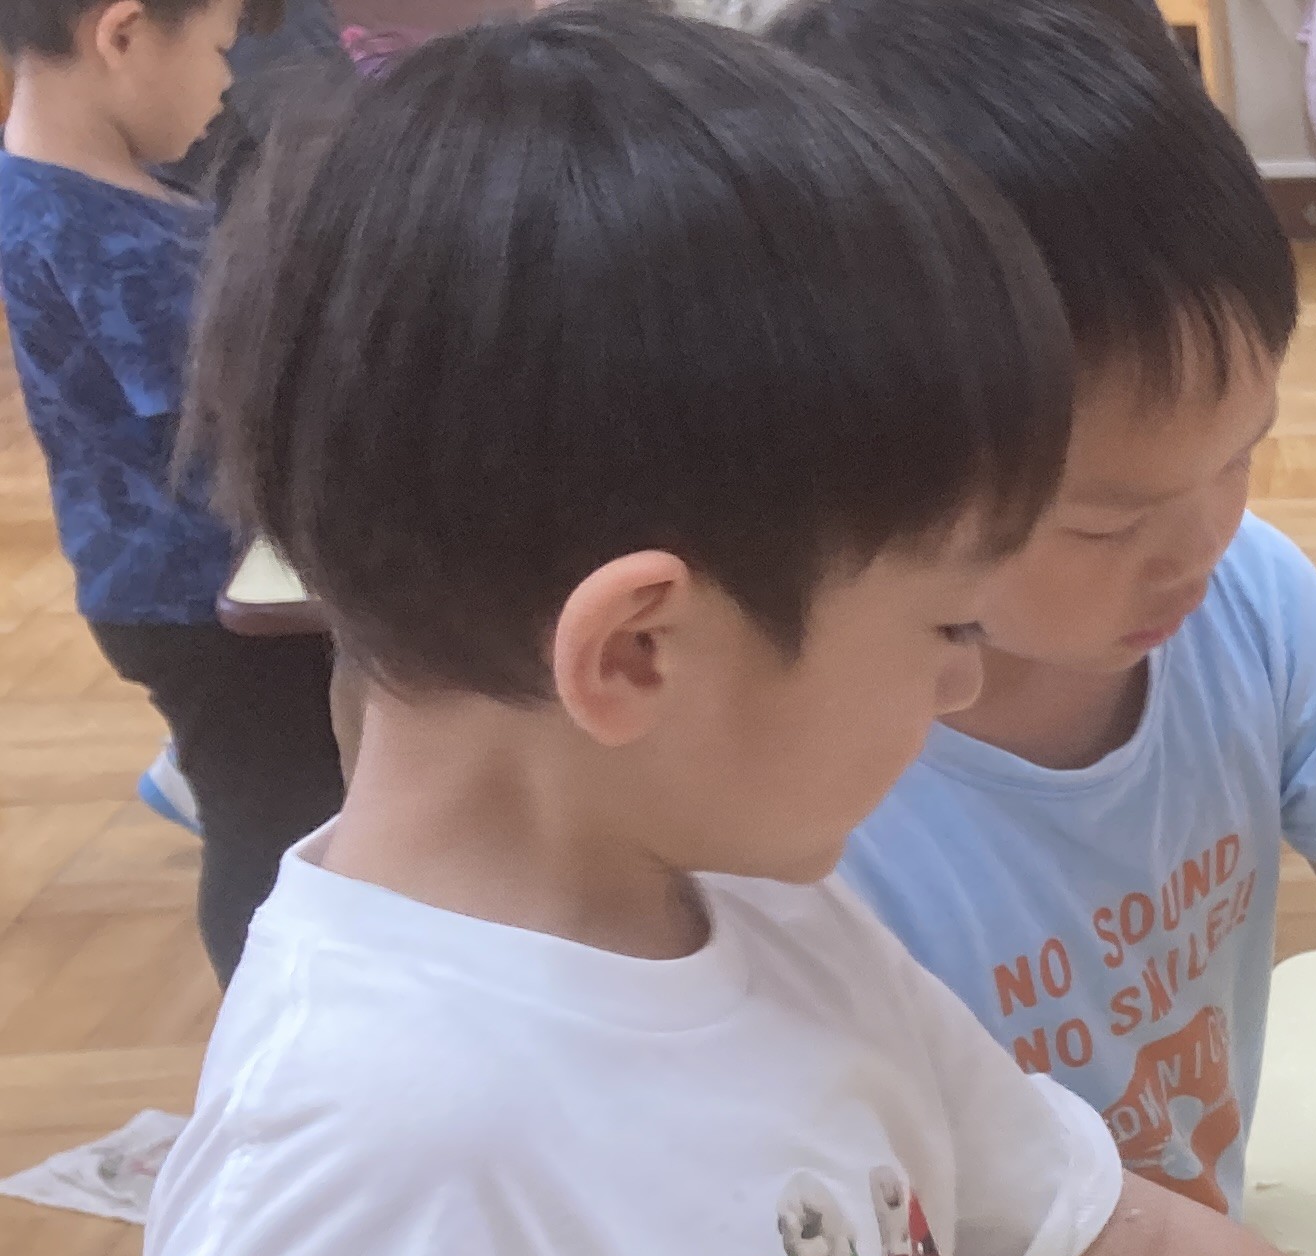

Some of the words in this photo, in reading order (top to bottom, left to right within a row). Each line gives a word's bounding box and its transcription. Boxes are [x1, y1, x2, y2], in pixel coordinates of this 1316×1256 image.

[993, 937, 1072, 1017] NO
[1092, 833, 1241, 969] SOUND
[1013, 1017, 1093, 1076] NO
